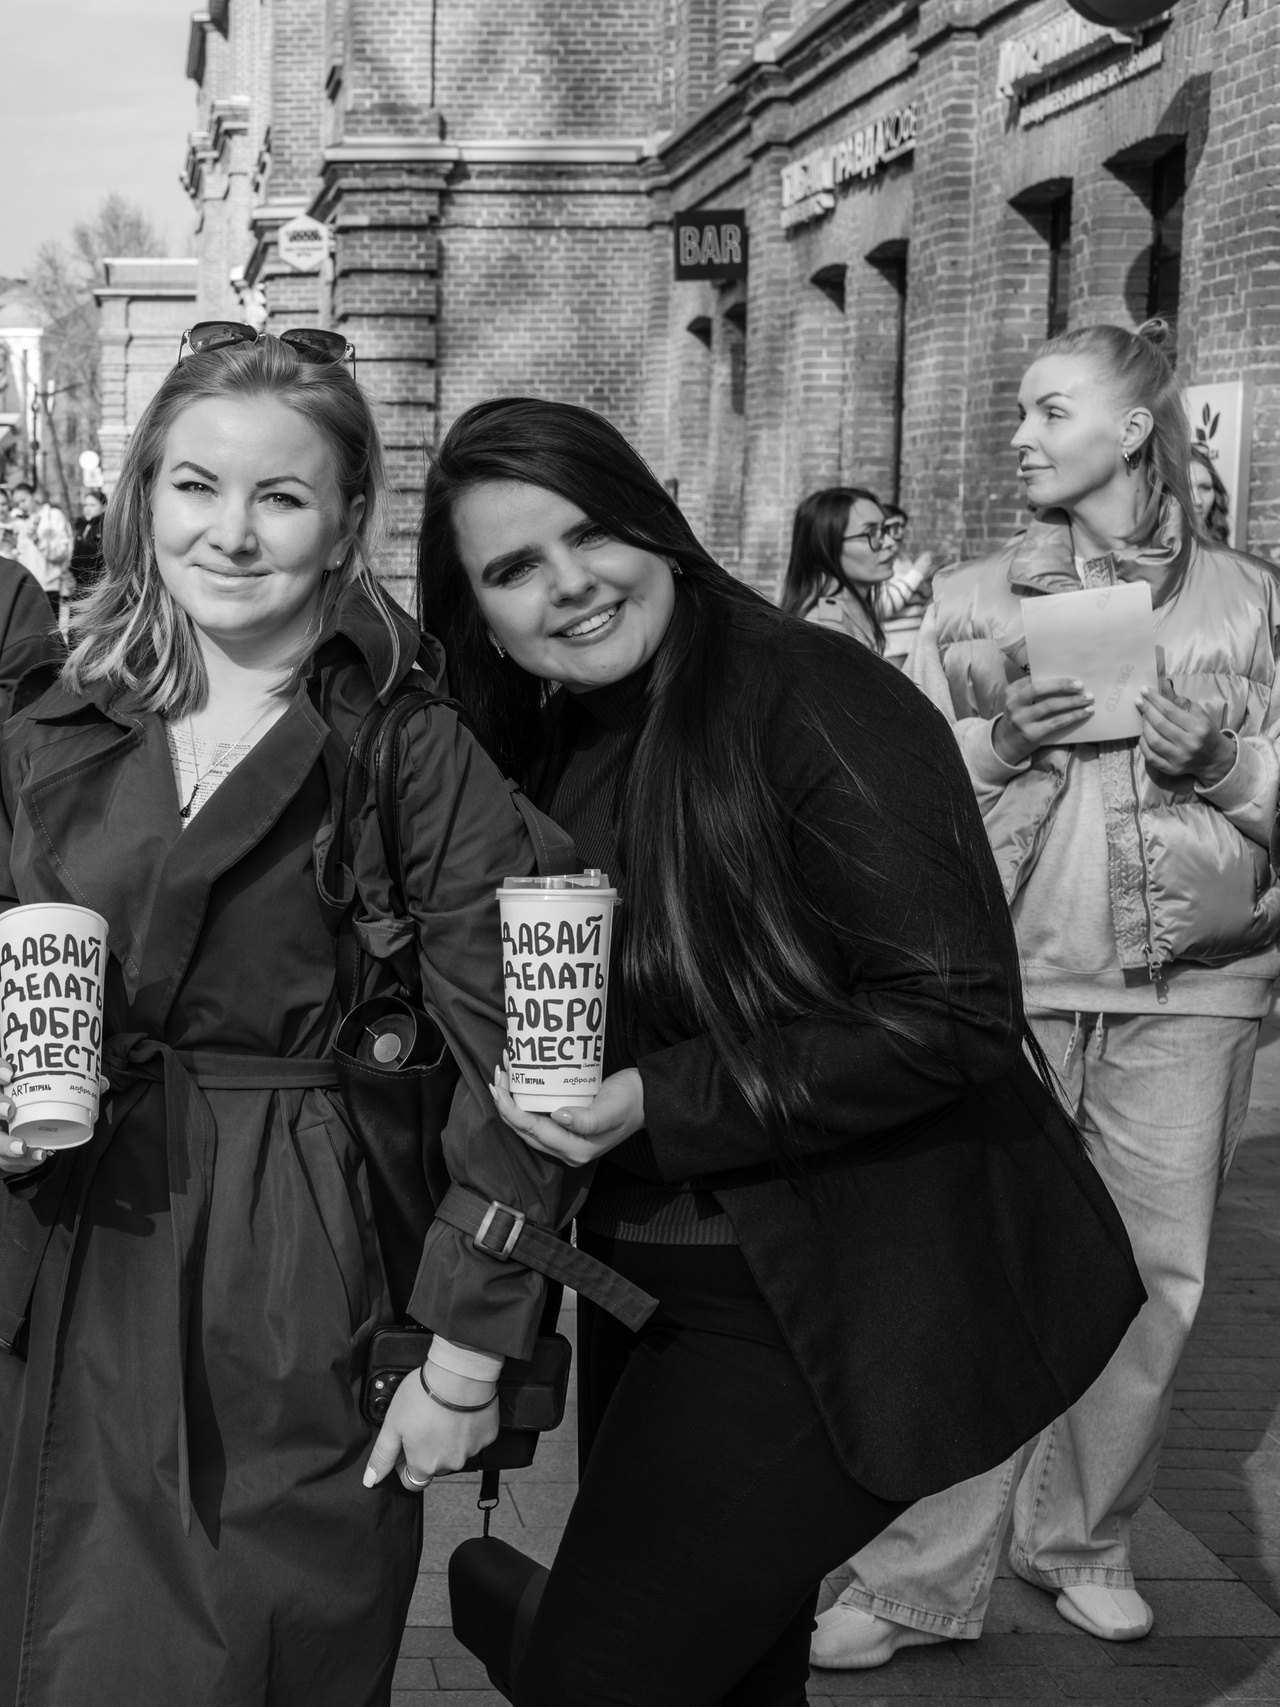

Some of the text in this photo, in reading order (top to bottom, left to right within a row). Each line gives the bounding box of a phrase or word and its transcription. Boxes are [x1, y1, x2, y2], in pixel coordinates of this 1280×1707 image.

[679, 223, 742, 267] BAR
[502, 914, 603, 956] ДАВАЙ
[0, 933, 102, 982] ДАВАЙ
[504, 960, 604, 991] ДЕЛАТЬ
[1, 972, 103, 1011] ДЕЛАТЬ
[3, 1007, 101, 1051] ДОБРО
[505, 995, 603, 1033] ДОБРО
[506, 1035, 603, 1062] ВМЕСТЕ
[563, 1076, 596, 1085] добро.рф
